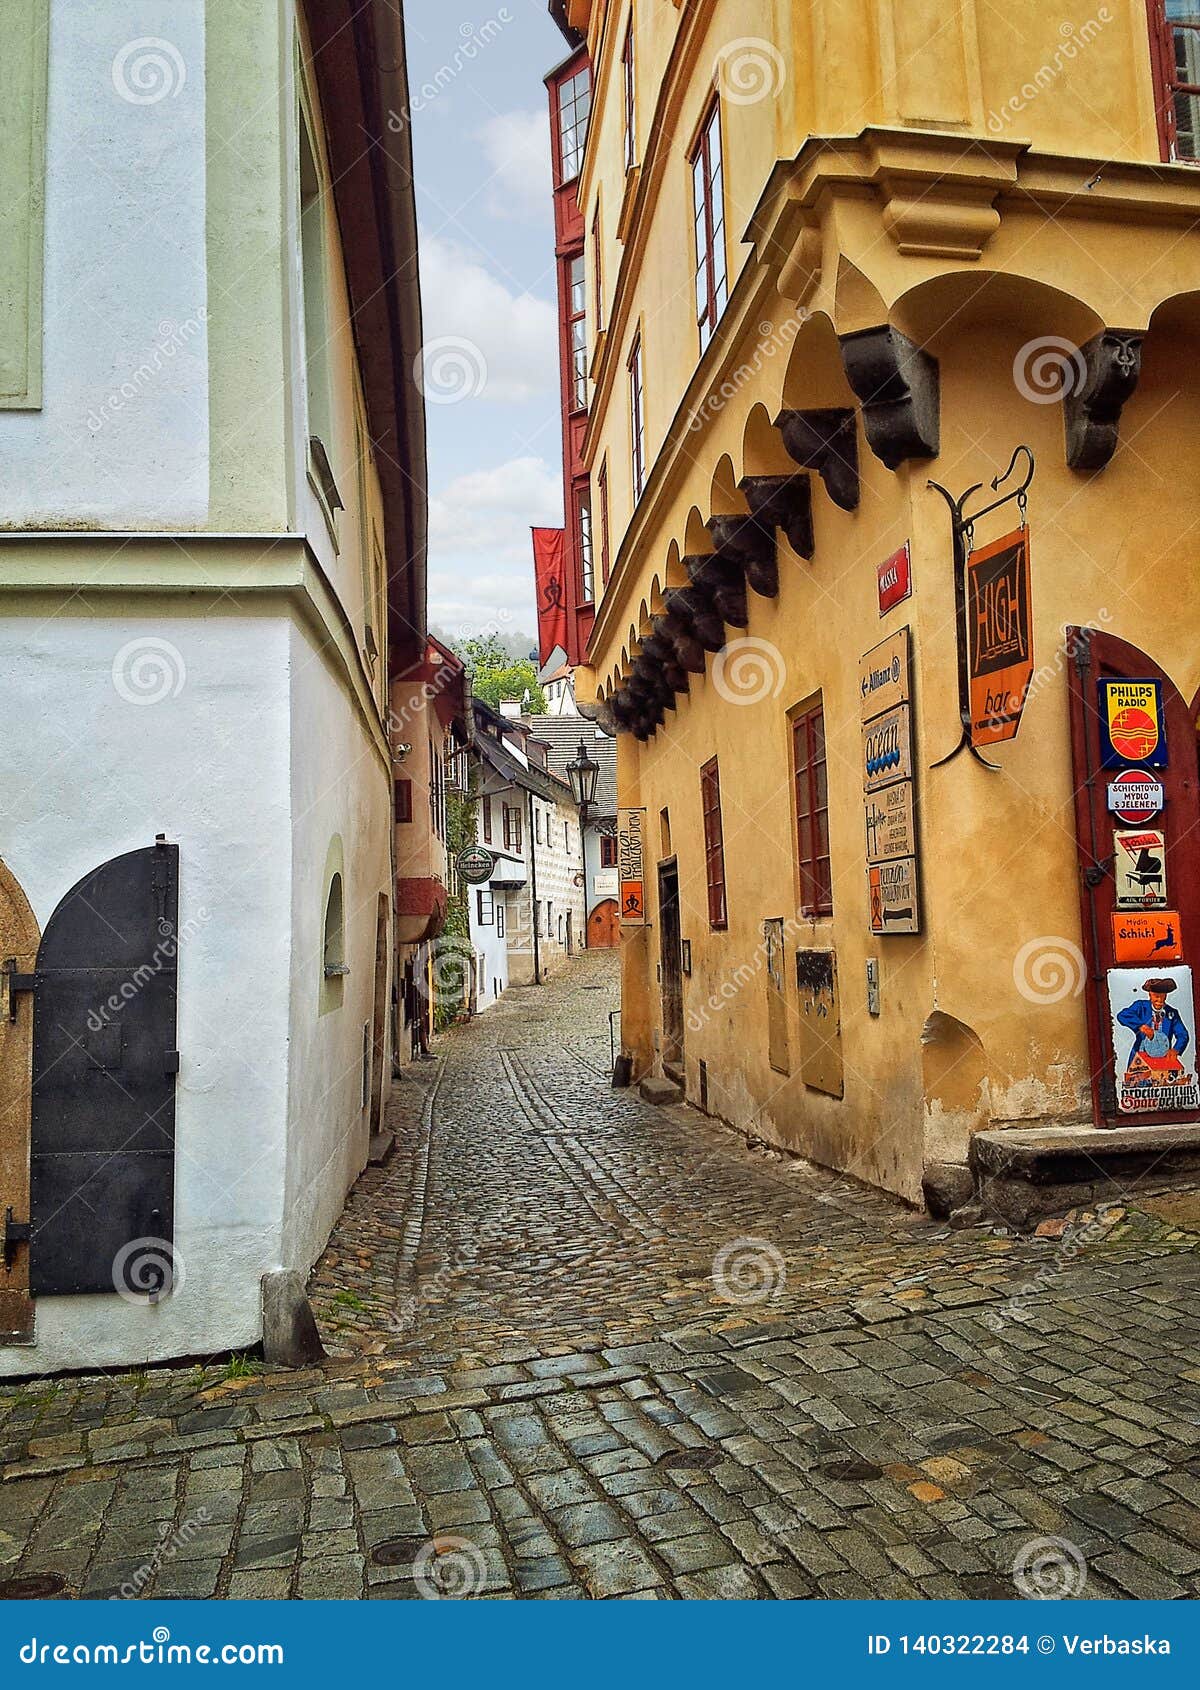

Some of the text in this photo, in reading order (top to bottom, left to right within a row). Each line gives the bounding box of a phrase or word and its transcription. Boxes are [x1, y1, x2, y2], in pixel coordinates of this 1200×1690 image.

[972, 547, 1024, 673] HIGH
[869, 666, 891, 692] Allianz
[1110, 686, 1152, 697] PHILIPS
[984, 688, 1010, 715] bar
[1118, 699, 1146, 707] RADIO
[866, 723, 898, 763] ocean
[1112, 784, 1159, 793] SCHICHTOVO
[460, 861, 490, 869] Heineken
